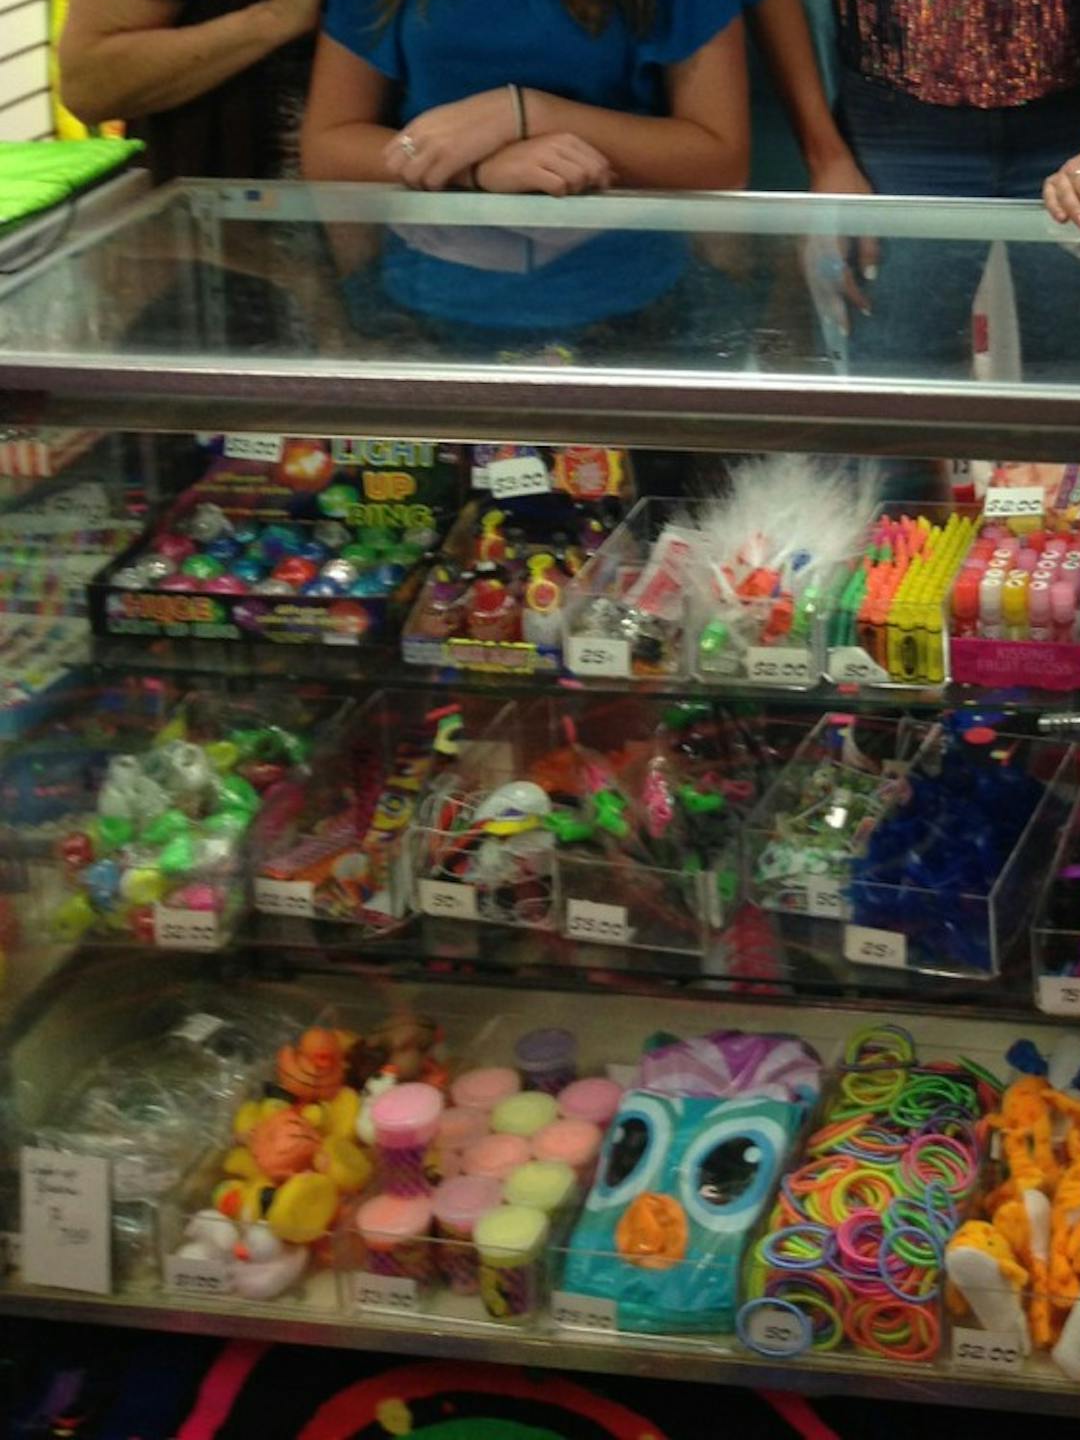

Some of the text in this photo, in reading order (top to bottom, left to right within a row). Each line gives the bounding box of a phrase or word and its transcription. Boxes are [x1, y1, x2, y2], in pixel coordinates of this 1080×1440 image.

[332, 438, 436, 467] LIGHT
[362, 470, 417, 502] UP
[347, 503, 433, 529] RING
[976, 659, 1073, 675] FRUIT GLOSS
